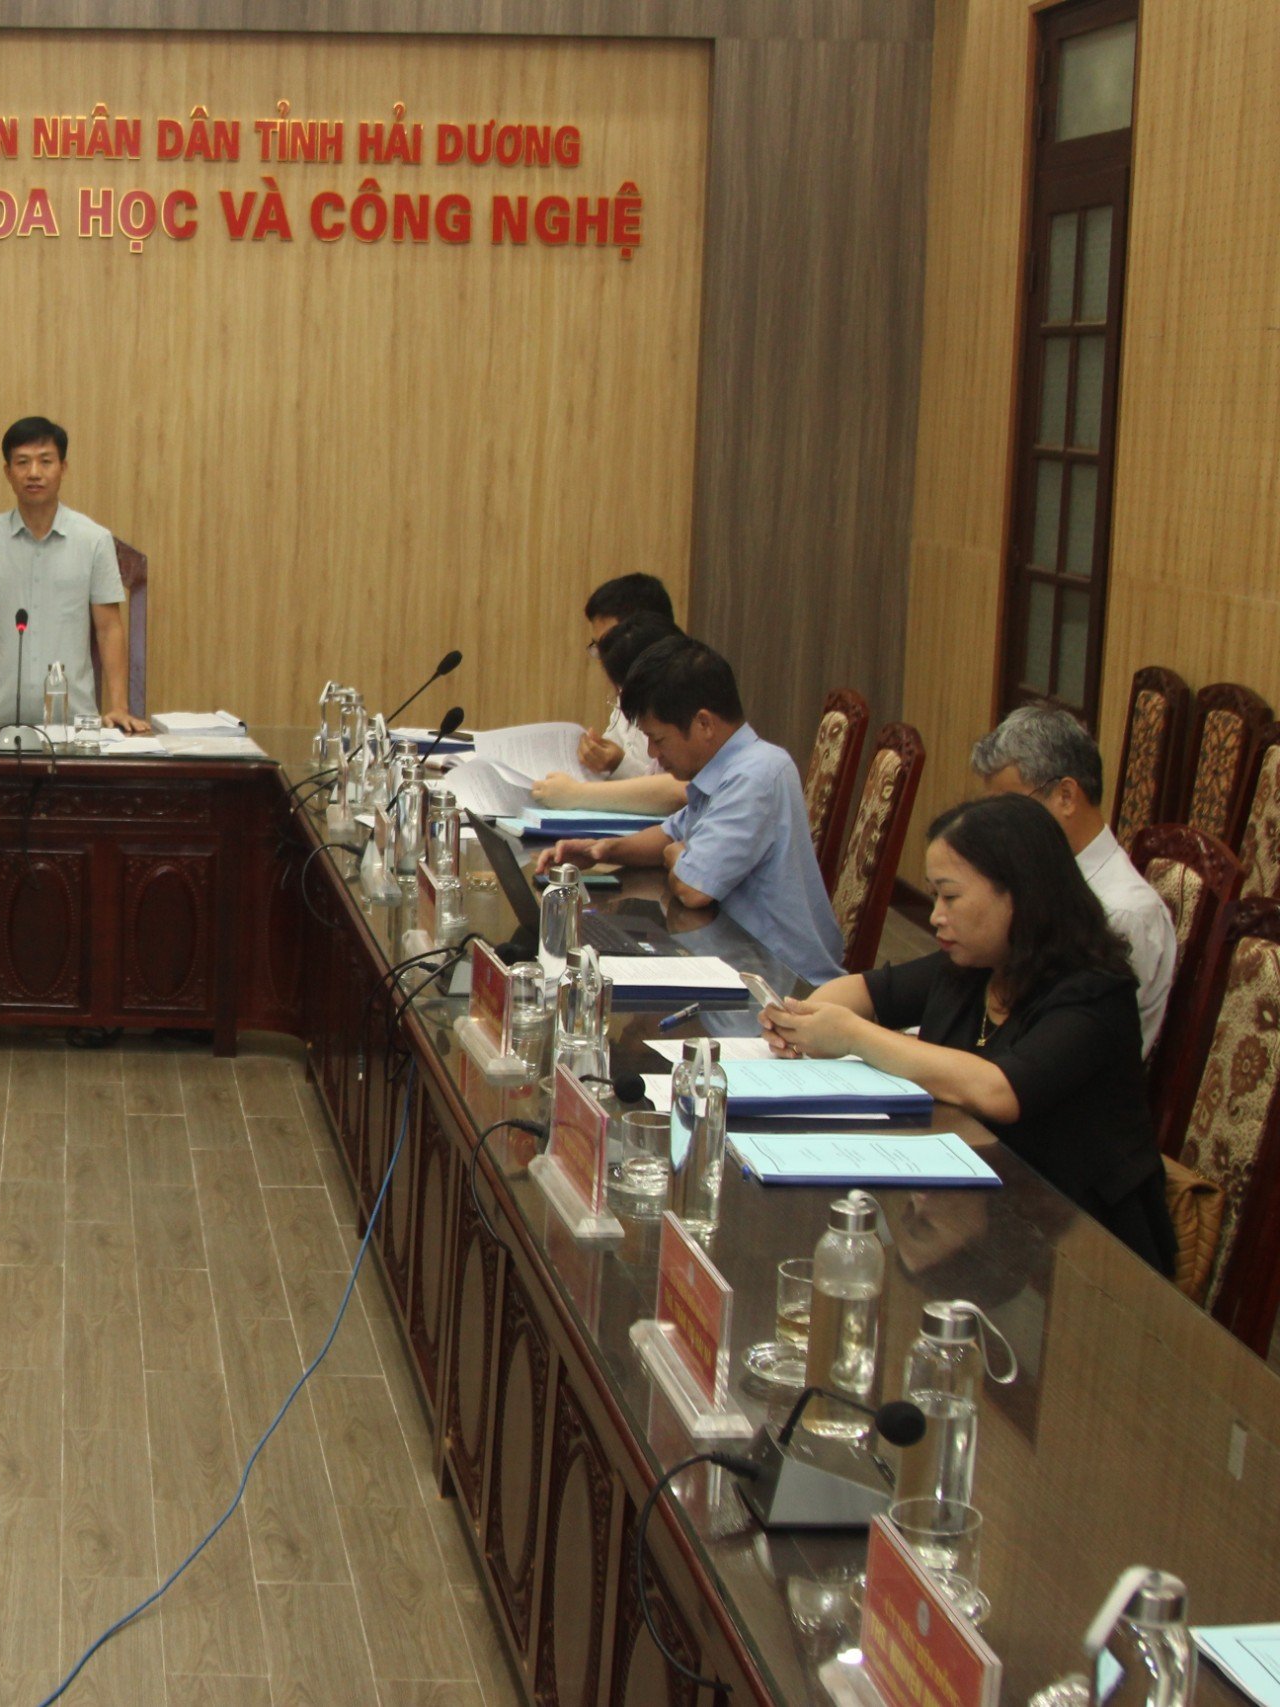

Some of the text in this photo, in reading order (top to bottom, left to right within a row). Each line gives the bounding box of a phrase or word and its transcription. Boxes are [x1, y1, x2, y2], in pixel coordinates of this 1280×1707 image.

[32, 103, 141, 160] NHÂN
[156, 105, 240, 161] DÂN
[255, 99, 344, 164] TỈNH
[358, 101, 423, 165] HẢI
[436, 118, 581, 167] DƯƠNG
[78, 188, 198, 254] HỌC
[219, 176, 293, 242] VÀ
[310, 178, 472, 243] CÔNG
[491, 180, 643, 260] NGHỆ
